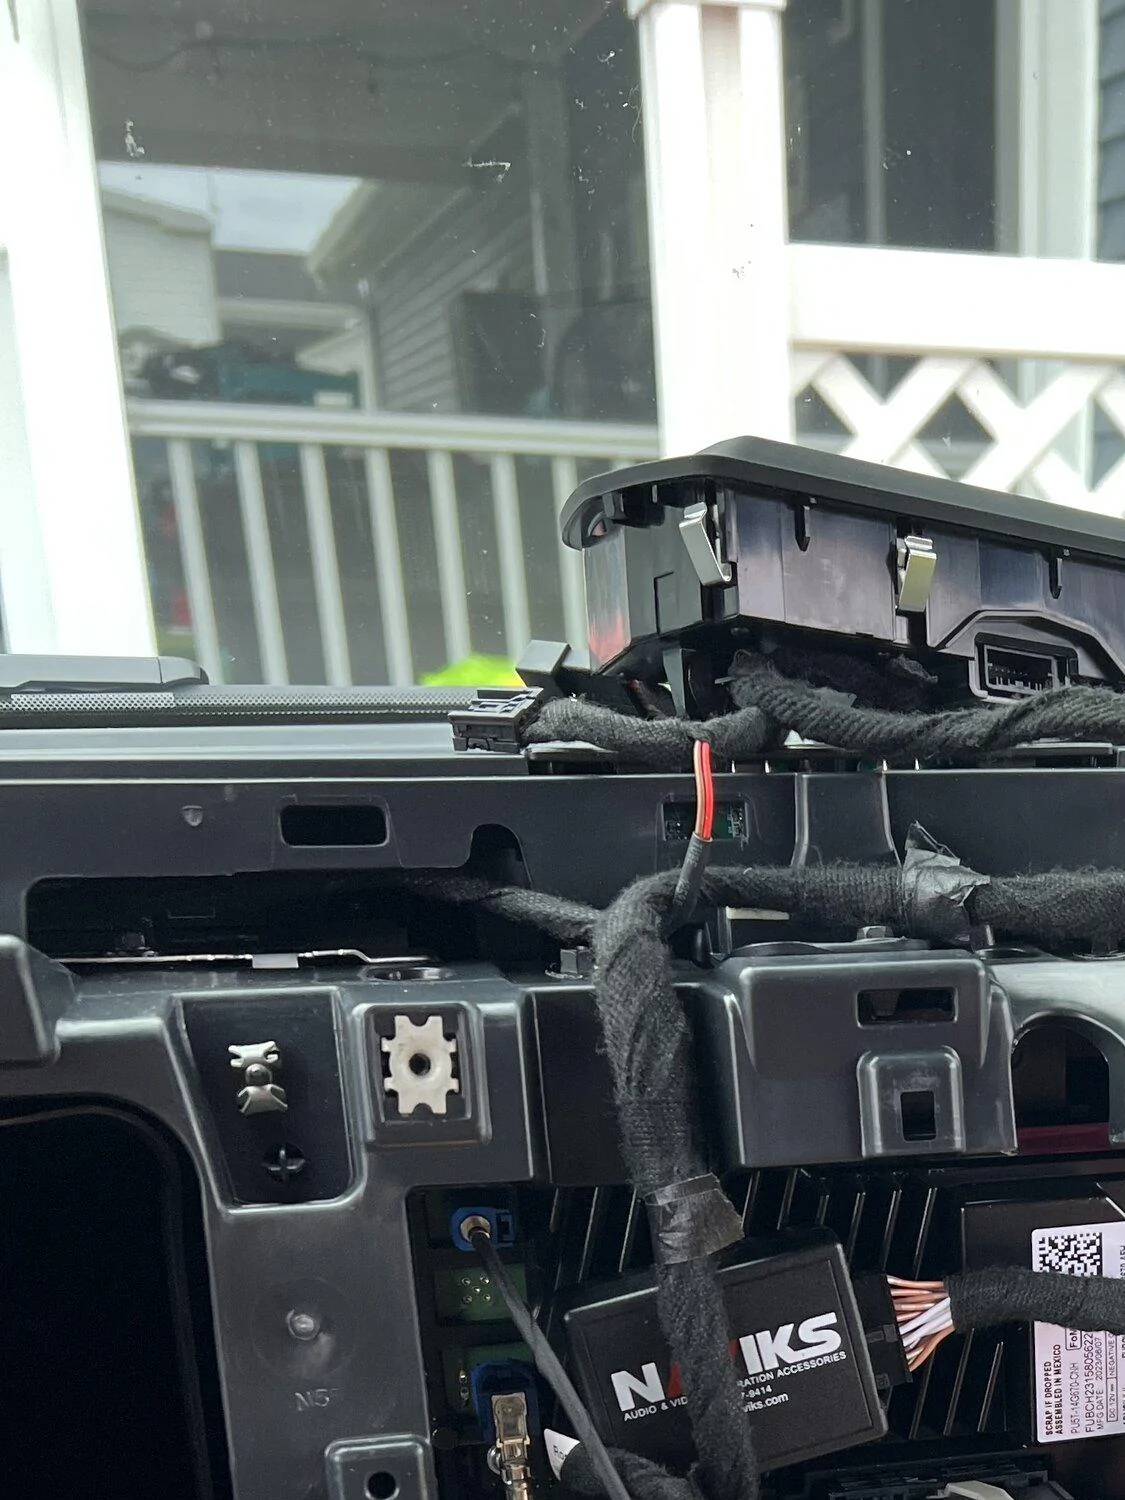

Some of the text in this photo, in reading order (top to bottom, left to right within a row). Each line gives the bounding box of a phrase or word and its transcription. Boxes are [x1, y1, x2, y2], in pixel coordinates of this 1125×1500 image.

[610, 1312, 842, 1412] NIKS
[1052, 1344, 1062, 1375] MEXICO
[1107, 1339, 1116, 1376] NEGATIVE
[623, 1405, 657, 1422] AUDIO
[661, 1402, 669, 1411] &
[670, 1395, 688, 1409] VID
[777, 1350, 847, 1379] ACCESSORIES
[1043, 1361, 1053, 1398] DROPPED
[1053, 1388, 1063, 1434] ASSEMBLED
[1096, 1389, 1105, 1410] DATE
[1045, 1410, 1054, 1435] SCRAP
[1096, 1411, 1105, 1430] MFG
